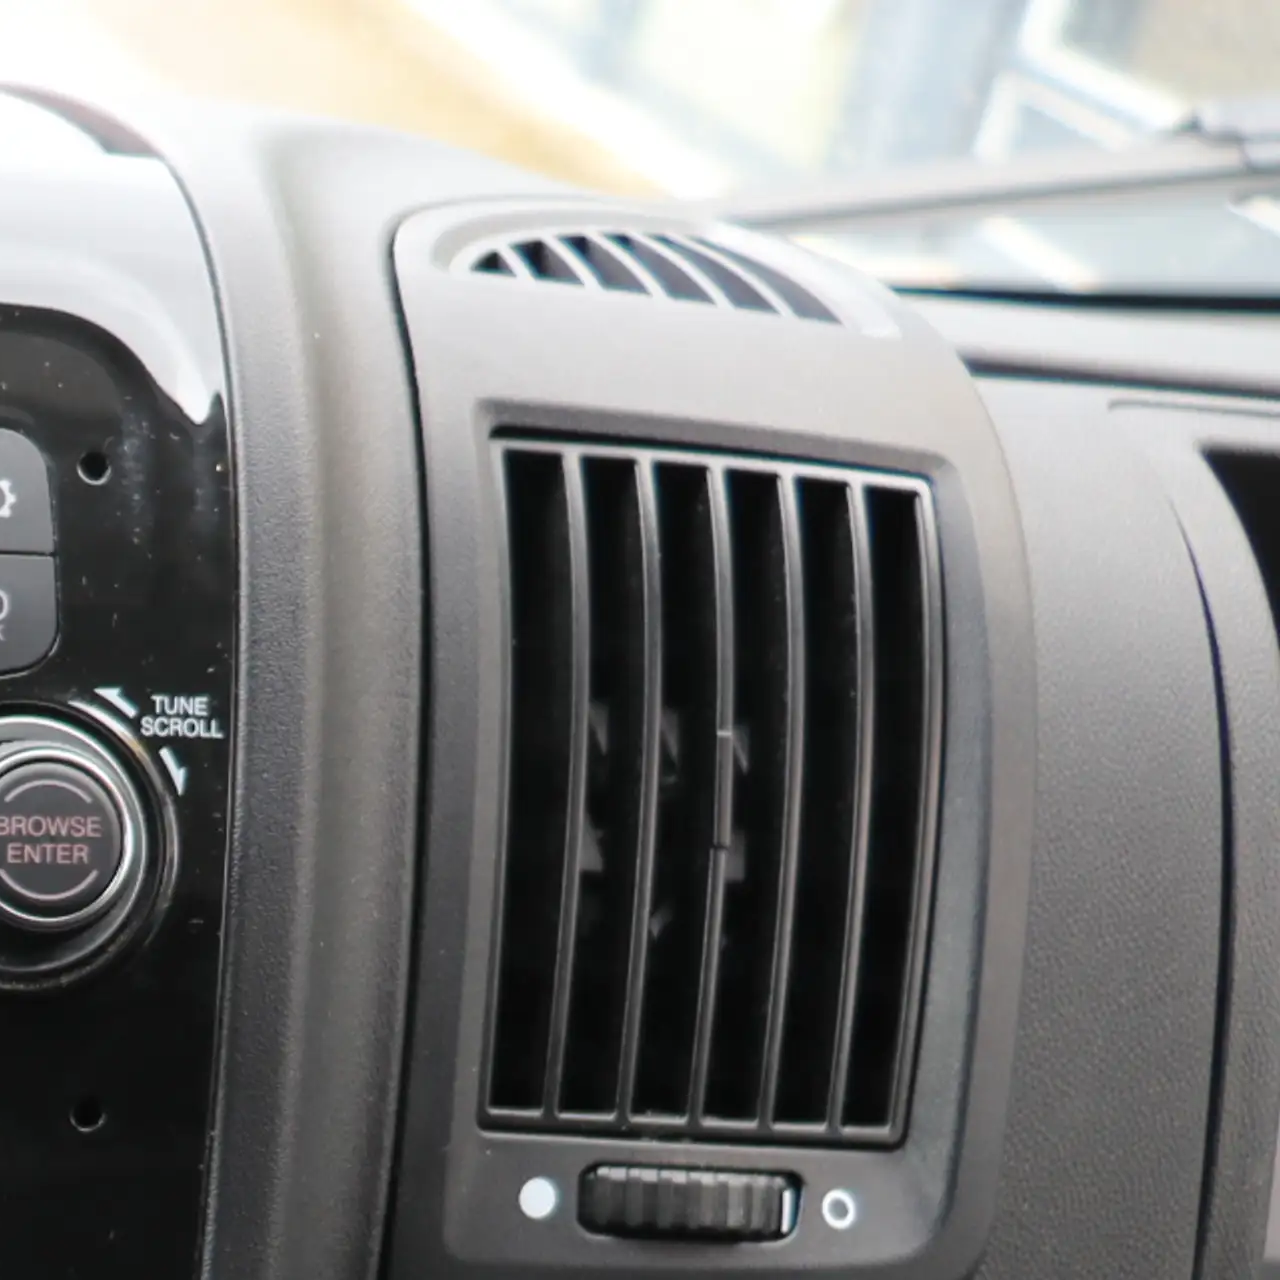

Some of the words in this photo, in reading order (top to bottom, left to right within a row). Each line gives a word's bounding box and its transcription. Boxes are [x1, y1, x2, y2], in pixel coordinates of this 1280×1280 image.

[151, 695, 209, 717] TUNE
[140, 716, 224, 739] SCROLL
[6, 842, 89, 865] ENTER
